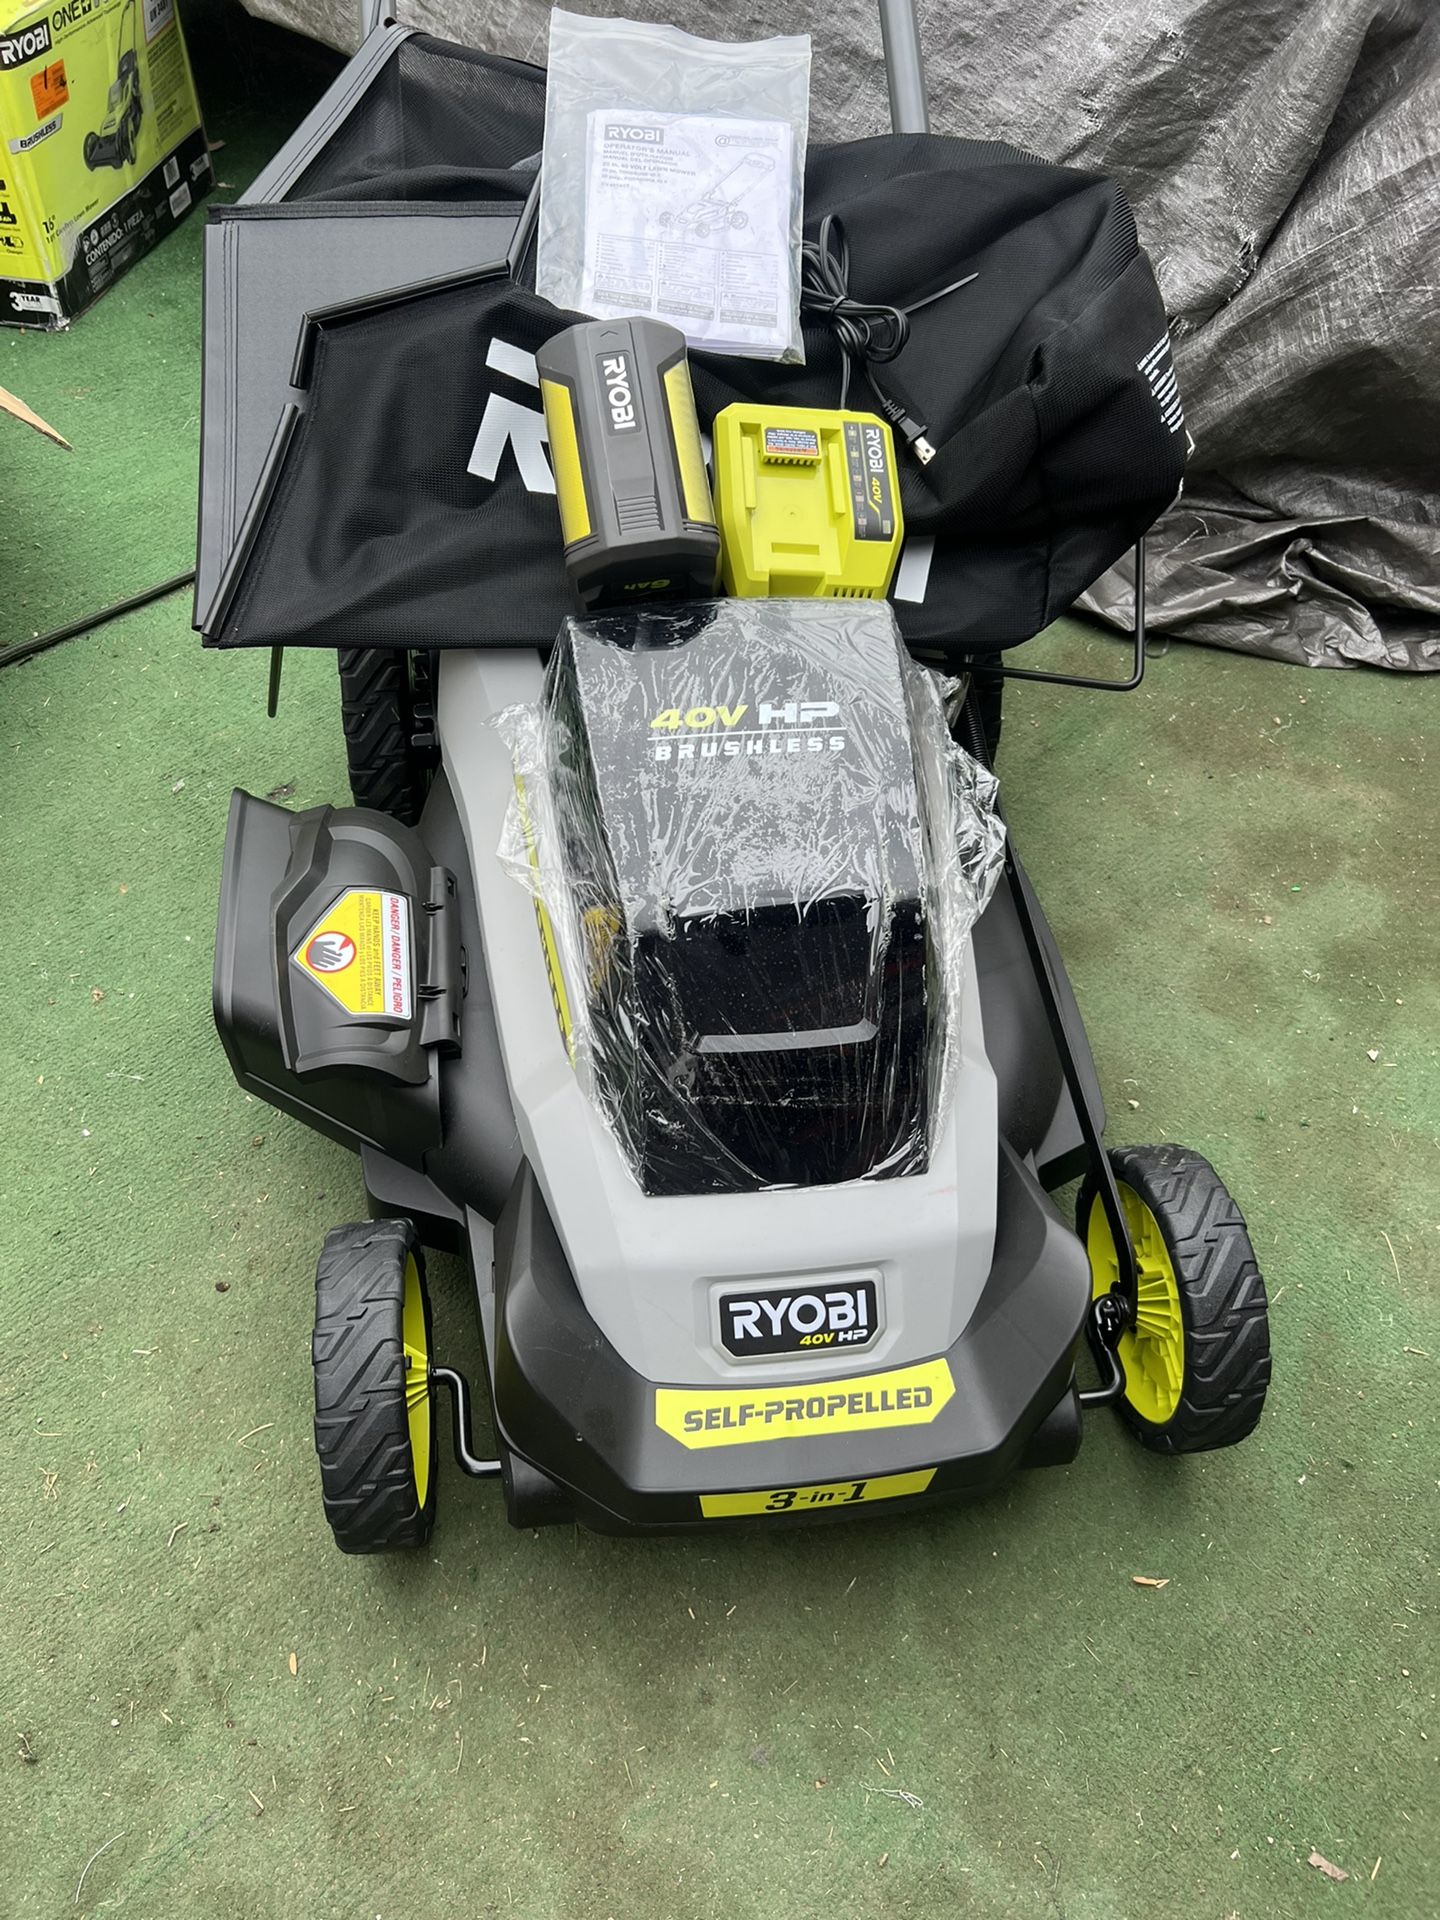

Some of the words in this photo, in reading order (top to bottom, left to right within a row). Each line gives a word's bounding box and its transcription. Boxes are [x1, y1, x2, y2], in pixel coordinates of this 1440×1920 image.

[0, 24, 49, 64] RYOBI
[20, 120, 57, 149] BRUSHLESS
[607, 127, 660, 142] RYOBI
[603, 143, 655, 153] OPERATOR'S
[656, 148, 690, 157] MANUAL
[9, 291, 22, 311] 3
[603, 356, 636, 430] RYOBI
[866, 428, 884, 473] RYOBI
[872, 476, 882, 504] 40V
[650, 704, 748, 729] 40V
[758, 701, 840, 724] HP
[655, 736, 845, 761] BRUSHLESS
[372, 908, 380, 924] KEEP
[390, 897, 400, 930] DANGER
[391, 935, 401, 970] DANGER
[392, 976, 403, 1013] PELIGRO
[729, 1289, 869, 1339] RYOBI
[799, 1331, 836, 1345] 40V
[838, 1328, 869, 1342] HP
[683, 1386, 933, 1433] SELF-PROPELLED
[764, 1481, 869, 1511] 3-in-1
